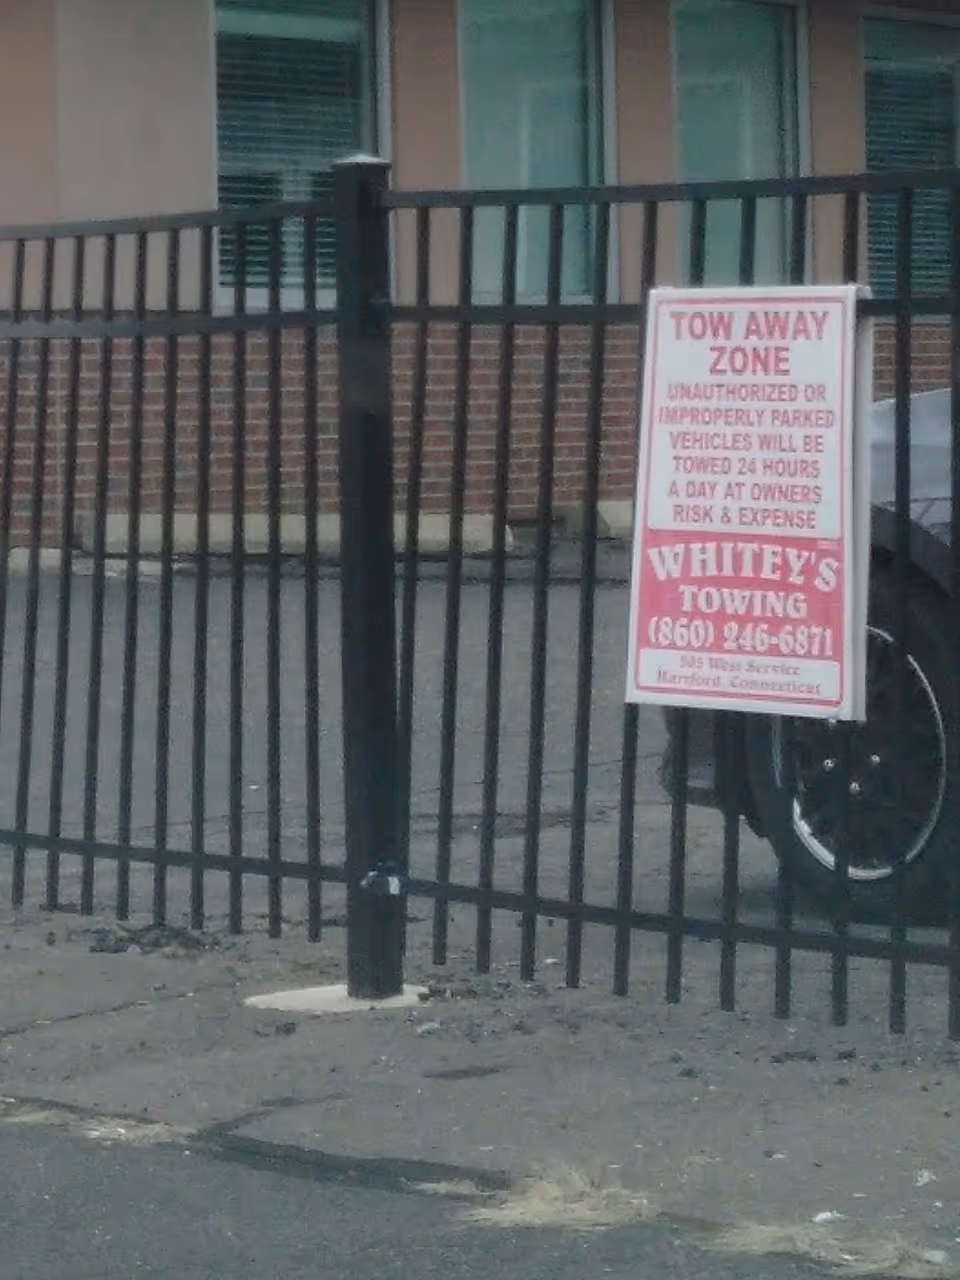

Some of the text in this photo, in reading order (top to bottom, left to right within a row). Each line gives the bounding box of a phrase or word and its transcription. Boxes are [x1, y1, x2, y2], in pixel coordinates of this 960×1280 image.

[669, 311, 829, 340] TOW AWAY
[709, 347, 790, 376] ZONE
[667, 384, 826, 403] UNAUTHORIZED OR
[658, 407, 835, 429] IMPROPERLY PARKED
[669, 432, 824, 453] VEHICLES WILL BE
[672, 456, 820, 478] TOWED 24 HOURS
[667, 480, 822, 504] A DAY AT OWNERS
[672, 505, 817, 529] RISK & EXPENSE
[647, 541, 839, 592] WHITEY'S
[679, 584, 807, 618] TOWING
[648, 616, 833, 656] (860) 246-6871
